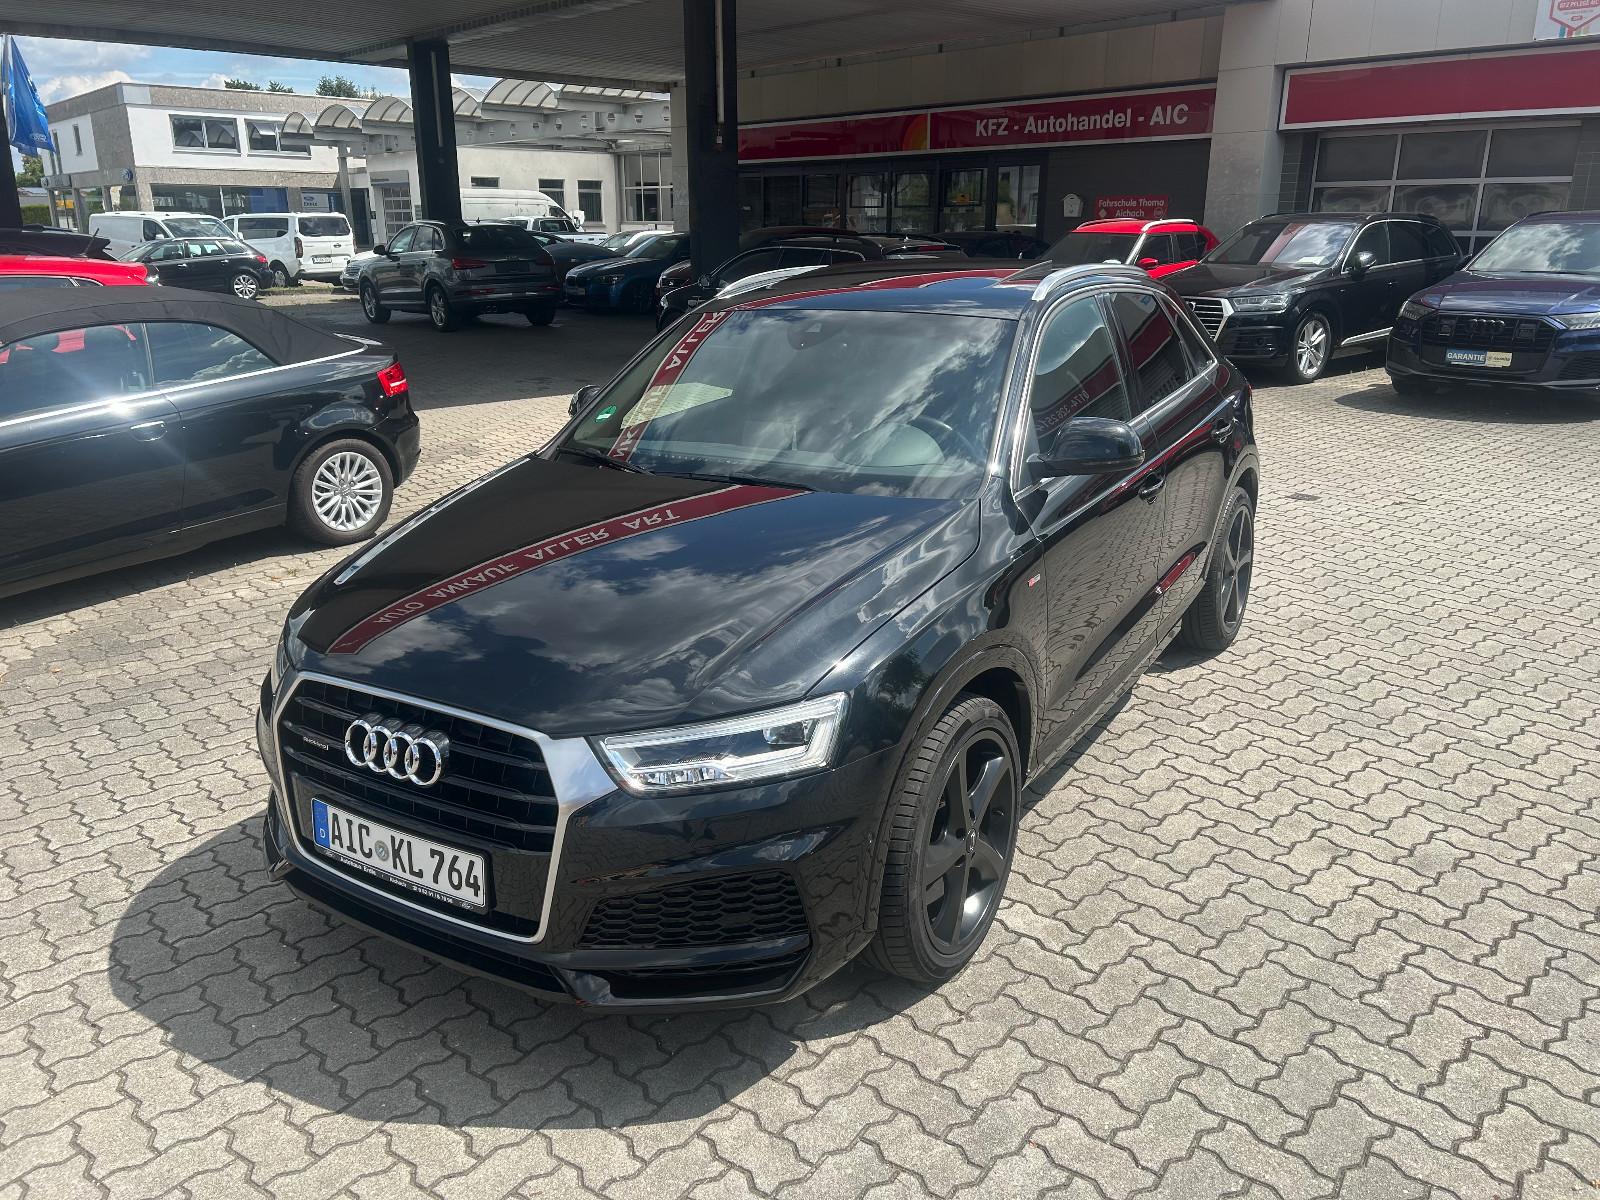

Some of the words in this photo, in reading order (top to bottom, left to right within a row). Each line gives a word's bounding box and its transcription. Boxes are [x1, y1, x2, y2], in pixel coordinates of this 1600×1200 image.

[975, 117, 1008, 137] KFZ
[1024, 108, 1132, 134] Autohandel
[1149, 103, 1189, 127] AIC
[1098, 199, 1136, 207] Fahrschule
[1139, 198, 1164, 207] Thoma
[1115, 208, 1145, 217] Aichach
[1447, 351, 1485, 362] GARANTIE
[319, 827, 326, 839] D
[331, 812, 373, 859] AIC
[390, 834, 424, 879] KL
[429, 847, 481, 897] 764
